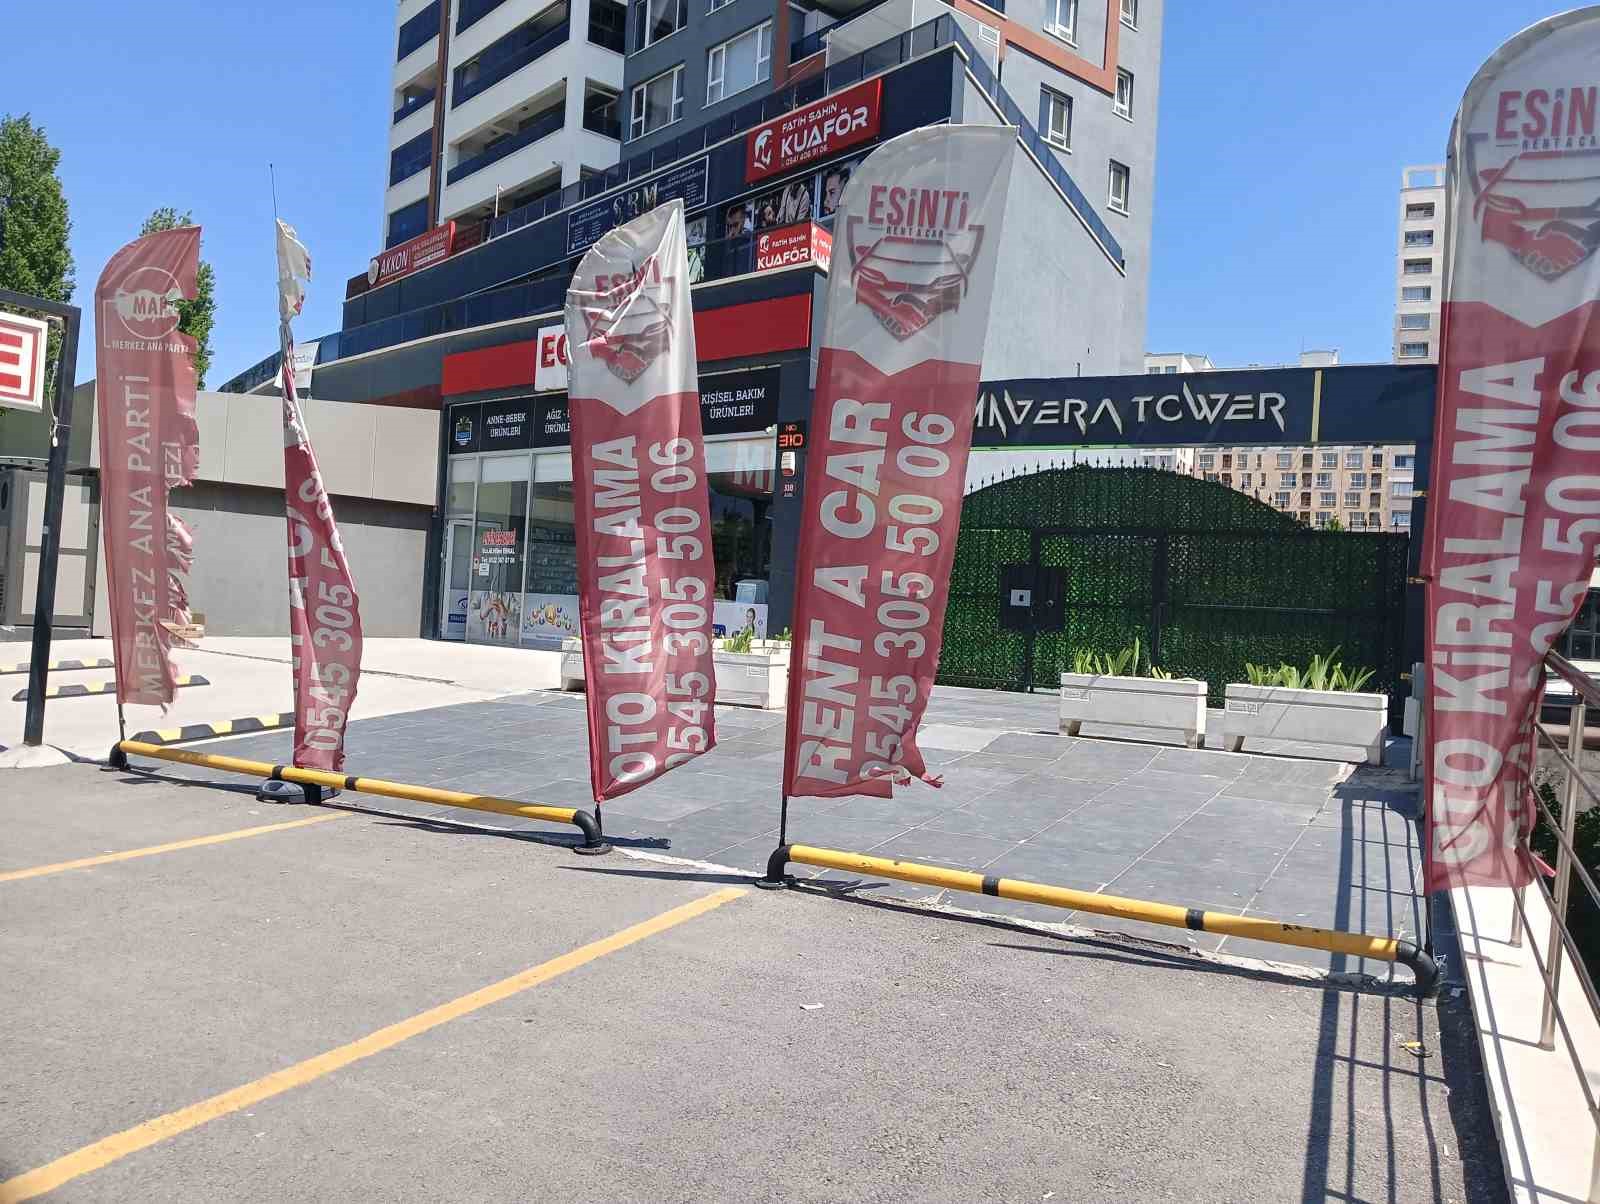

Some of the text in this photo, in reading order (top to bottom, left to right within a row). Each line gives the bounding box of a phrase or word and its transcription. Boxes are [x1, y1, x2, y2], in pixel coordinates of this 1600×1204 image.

[781, 106, 869, 158] KUAFÖR
[757, 246, 809, 270] KUAFÖR
[487, 412, 526, 425] ANNE-BEBEK
[701, 388, 766, 405] KİŞİSEL BAKIM
[709, 405, 754, 419] ÜRÜNLERİ
[1131, 382, 1286, 433] TOWER
[648, 437, 698, 493] 06
[778, 433, 804, 448] 310
[896, 411, 955, 478] 06
[128, 486, 153, 555] ANA
[654, 507, 703, 561] 50
[885, 494, 943, 556] 50
[313, 581, 354, 652] 305
[659, 576, 709, 657] 305
[798, 398, 892, 785] RENT A CAR
[874, 570, 934, 659] 305
[131, 567, 163, 698] MERKEZ
[303, 662, 350, 751] 0545
[606, 692, 658, 784] OTO
